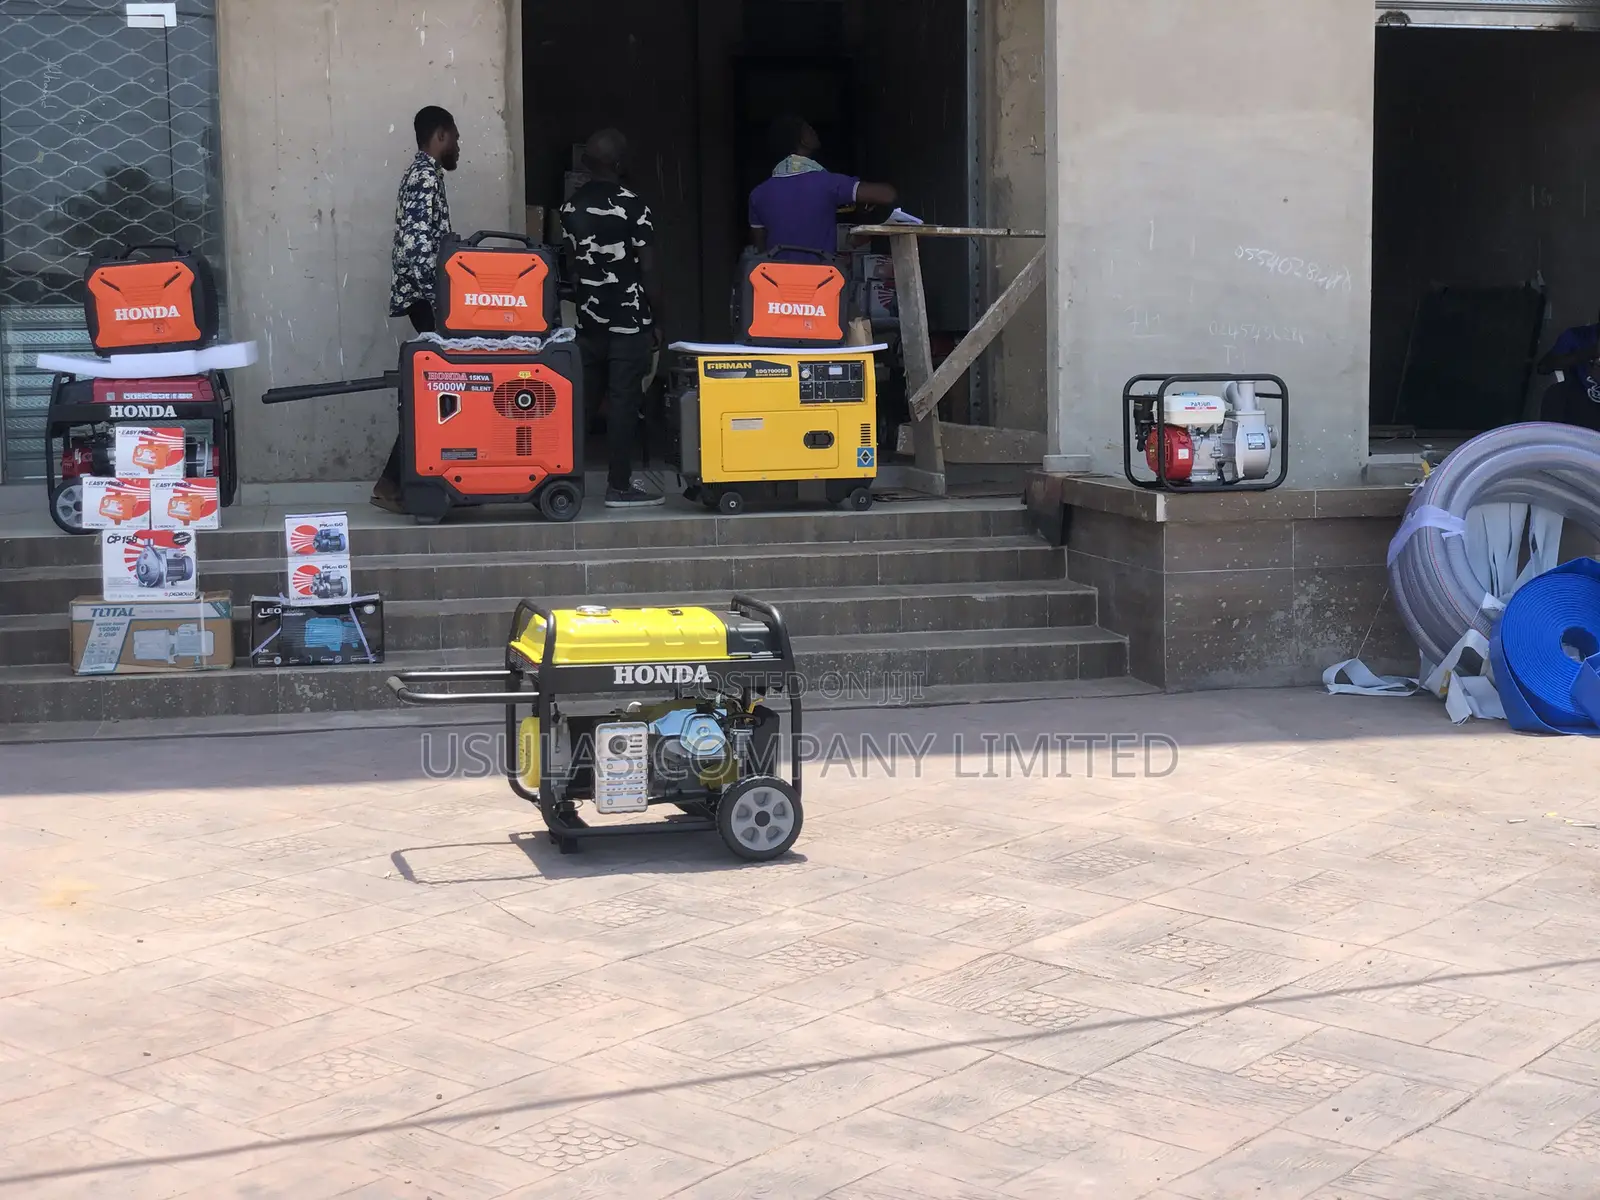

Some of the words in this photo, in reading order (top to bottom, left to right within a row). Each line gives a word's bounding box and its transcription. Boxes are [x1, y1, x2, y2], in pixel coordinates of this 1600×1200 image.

[464, 293, 528, 307] HONDA
[114, 305, 181, 321] HONDA
[767, 302, 827, 317] HONDA
[707, 362, 752, 370] FIRMAN
[427, 372, 468, 381] HONDA
[427, 383, 466, 391] 15000W
[109, 405, 177, 418] HONDA
[107, 535, 121, 544] CP
[122, 535, 138, 544] 158
[90, 607, 136, 618] TOTAL
[261, 607, 282, 615] LEO
[613, 664, 712, 685] HONDA
